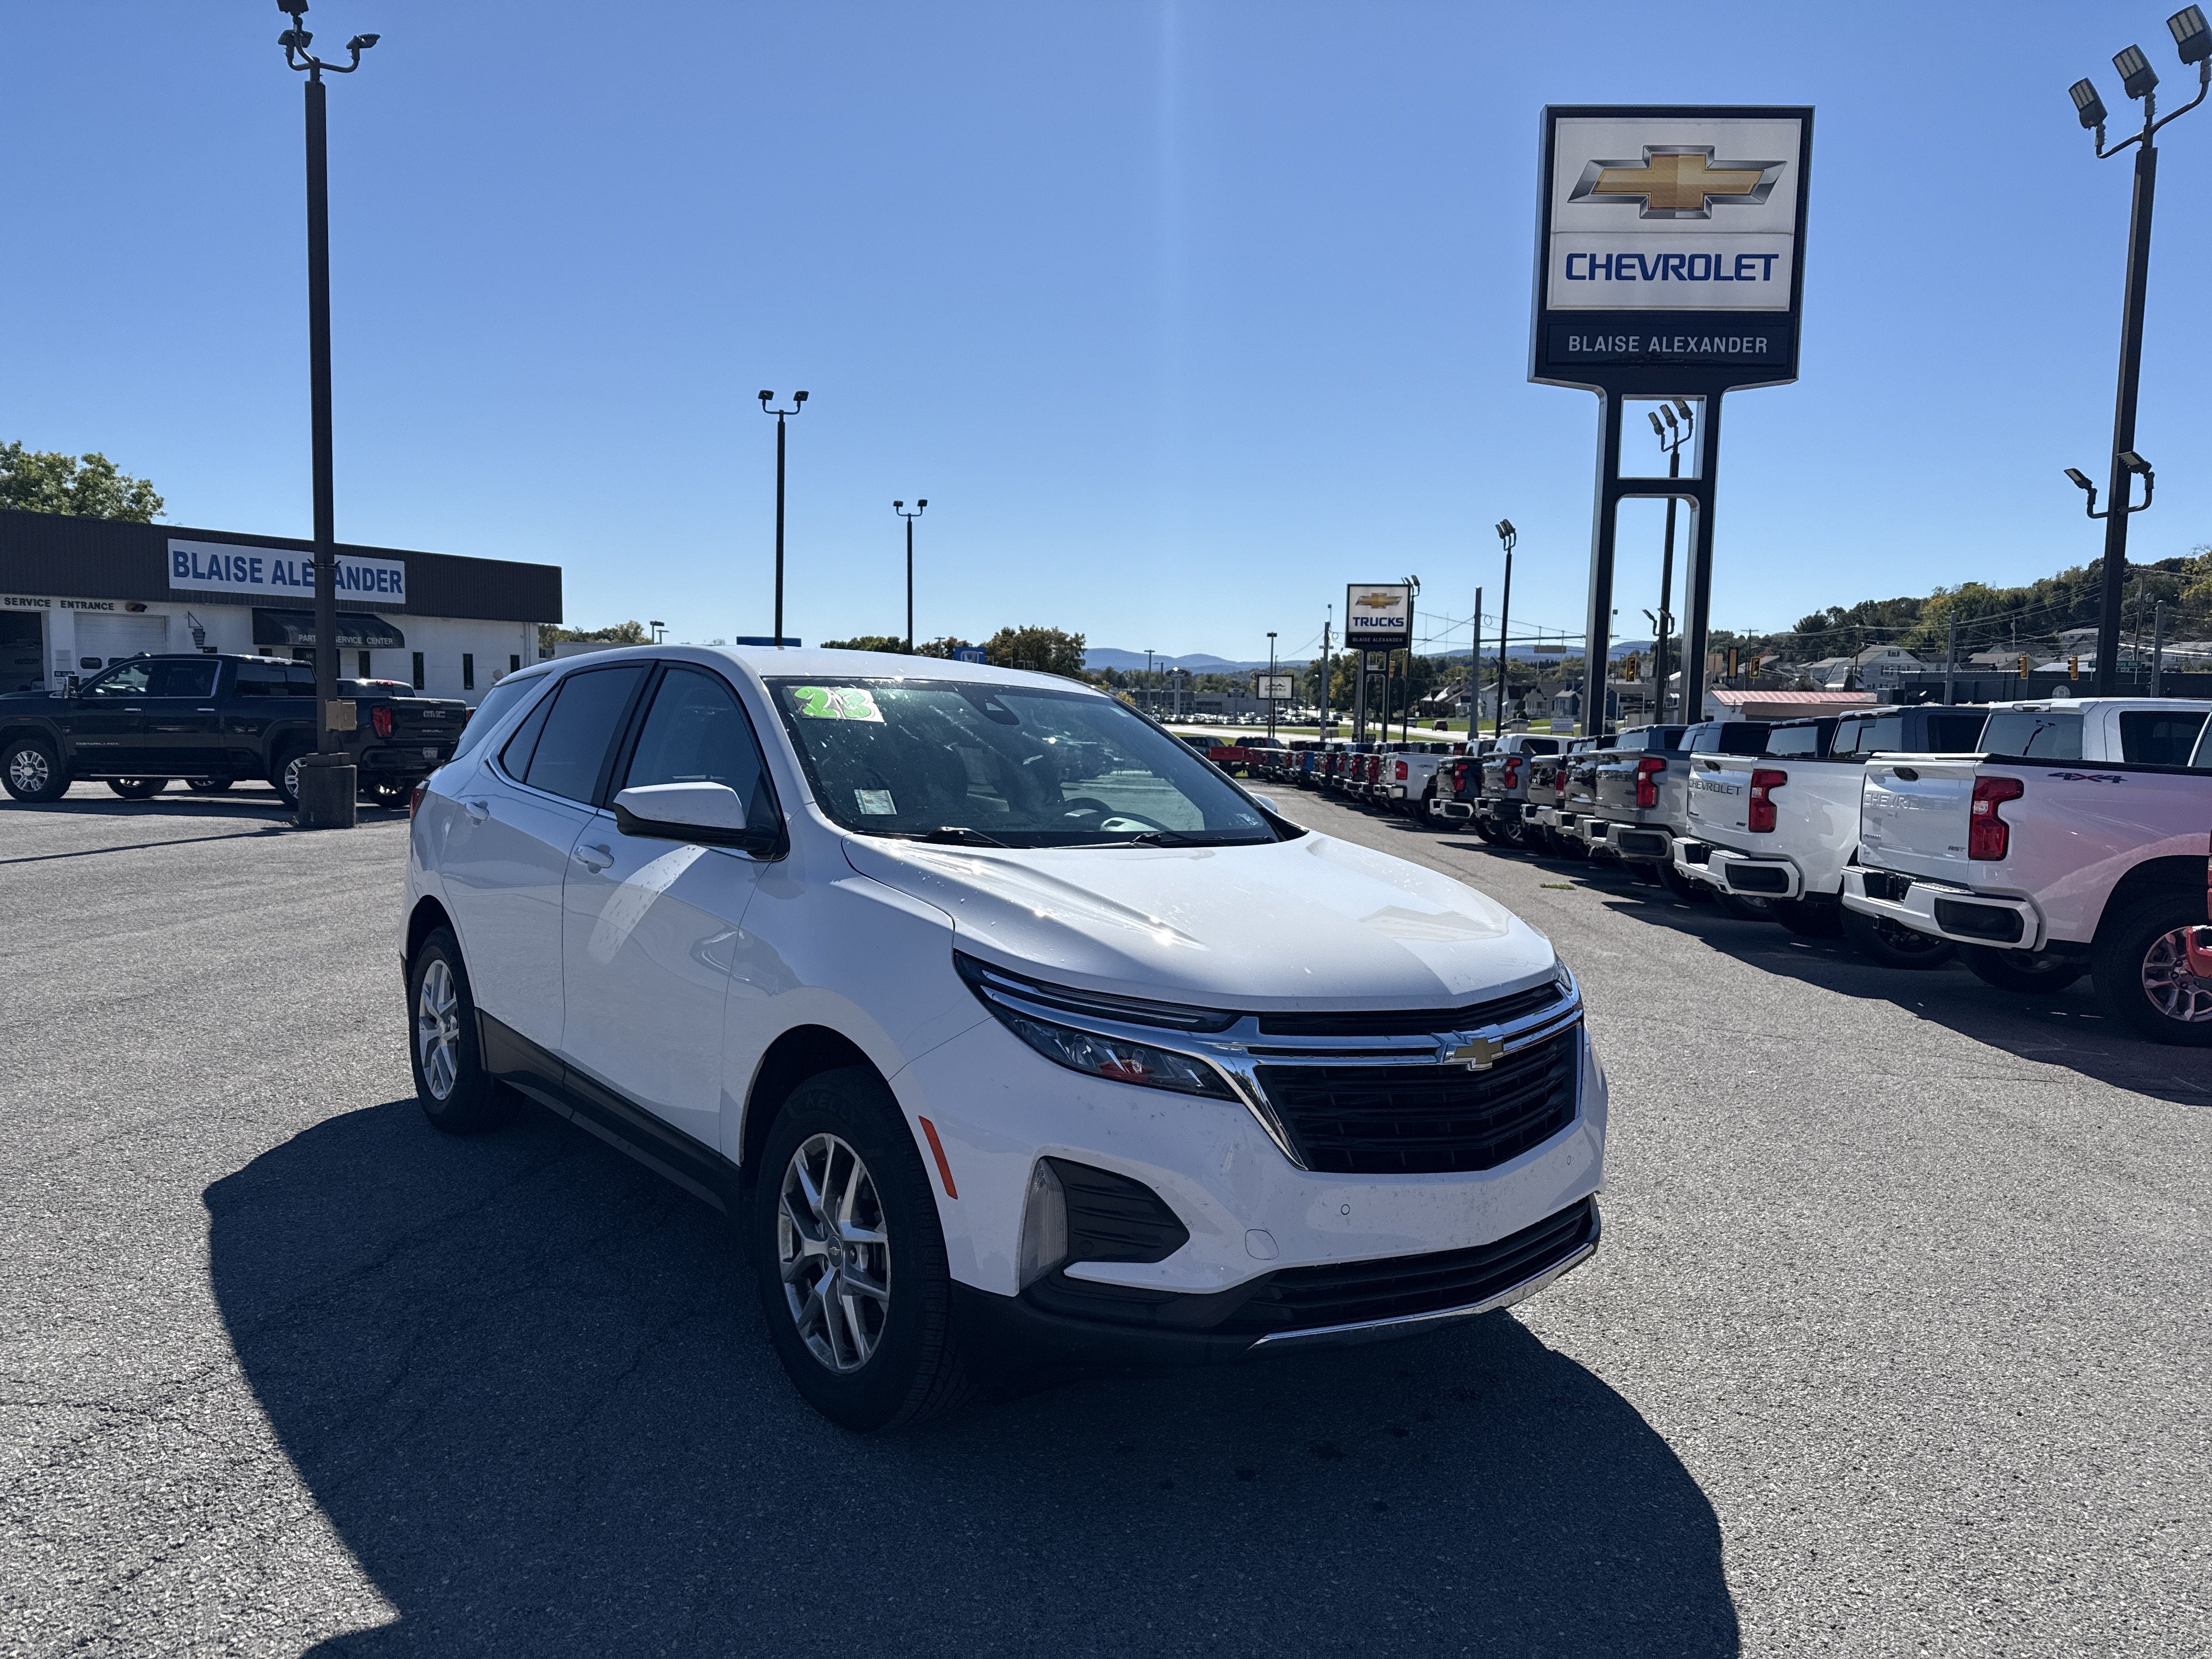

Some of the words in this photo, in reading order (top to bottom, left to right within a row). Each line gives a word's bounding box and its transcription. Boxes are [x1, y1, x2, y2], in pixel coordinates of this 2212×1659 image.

[1566, 253, 1780, 281] CHEVROLET
[1568, 335, 1640, 352] BLAISE
[1648, 336, 1768, 353] ALEXANDER
[172, 550, 263, 584] BLAISE
[271, 560, 403, 594] ALEANDER
[4, 597, 51, 607] SERVICE
[60, 600, 114, 610] ENTRANCE
[1352, 617, 1404, 627] TRUCKS
[298, 634, 317, 642] PART
[366, 637, 393, 645] CENTER
[794, 686, 872, 719] 23
[423, 710, 446, 719] GMC
[1688, 779, 1742, 796] CHEVROLET
